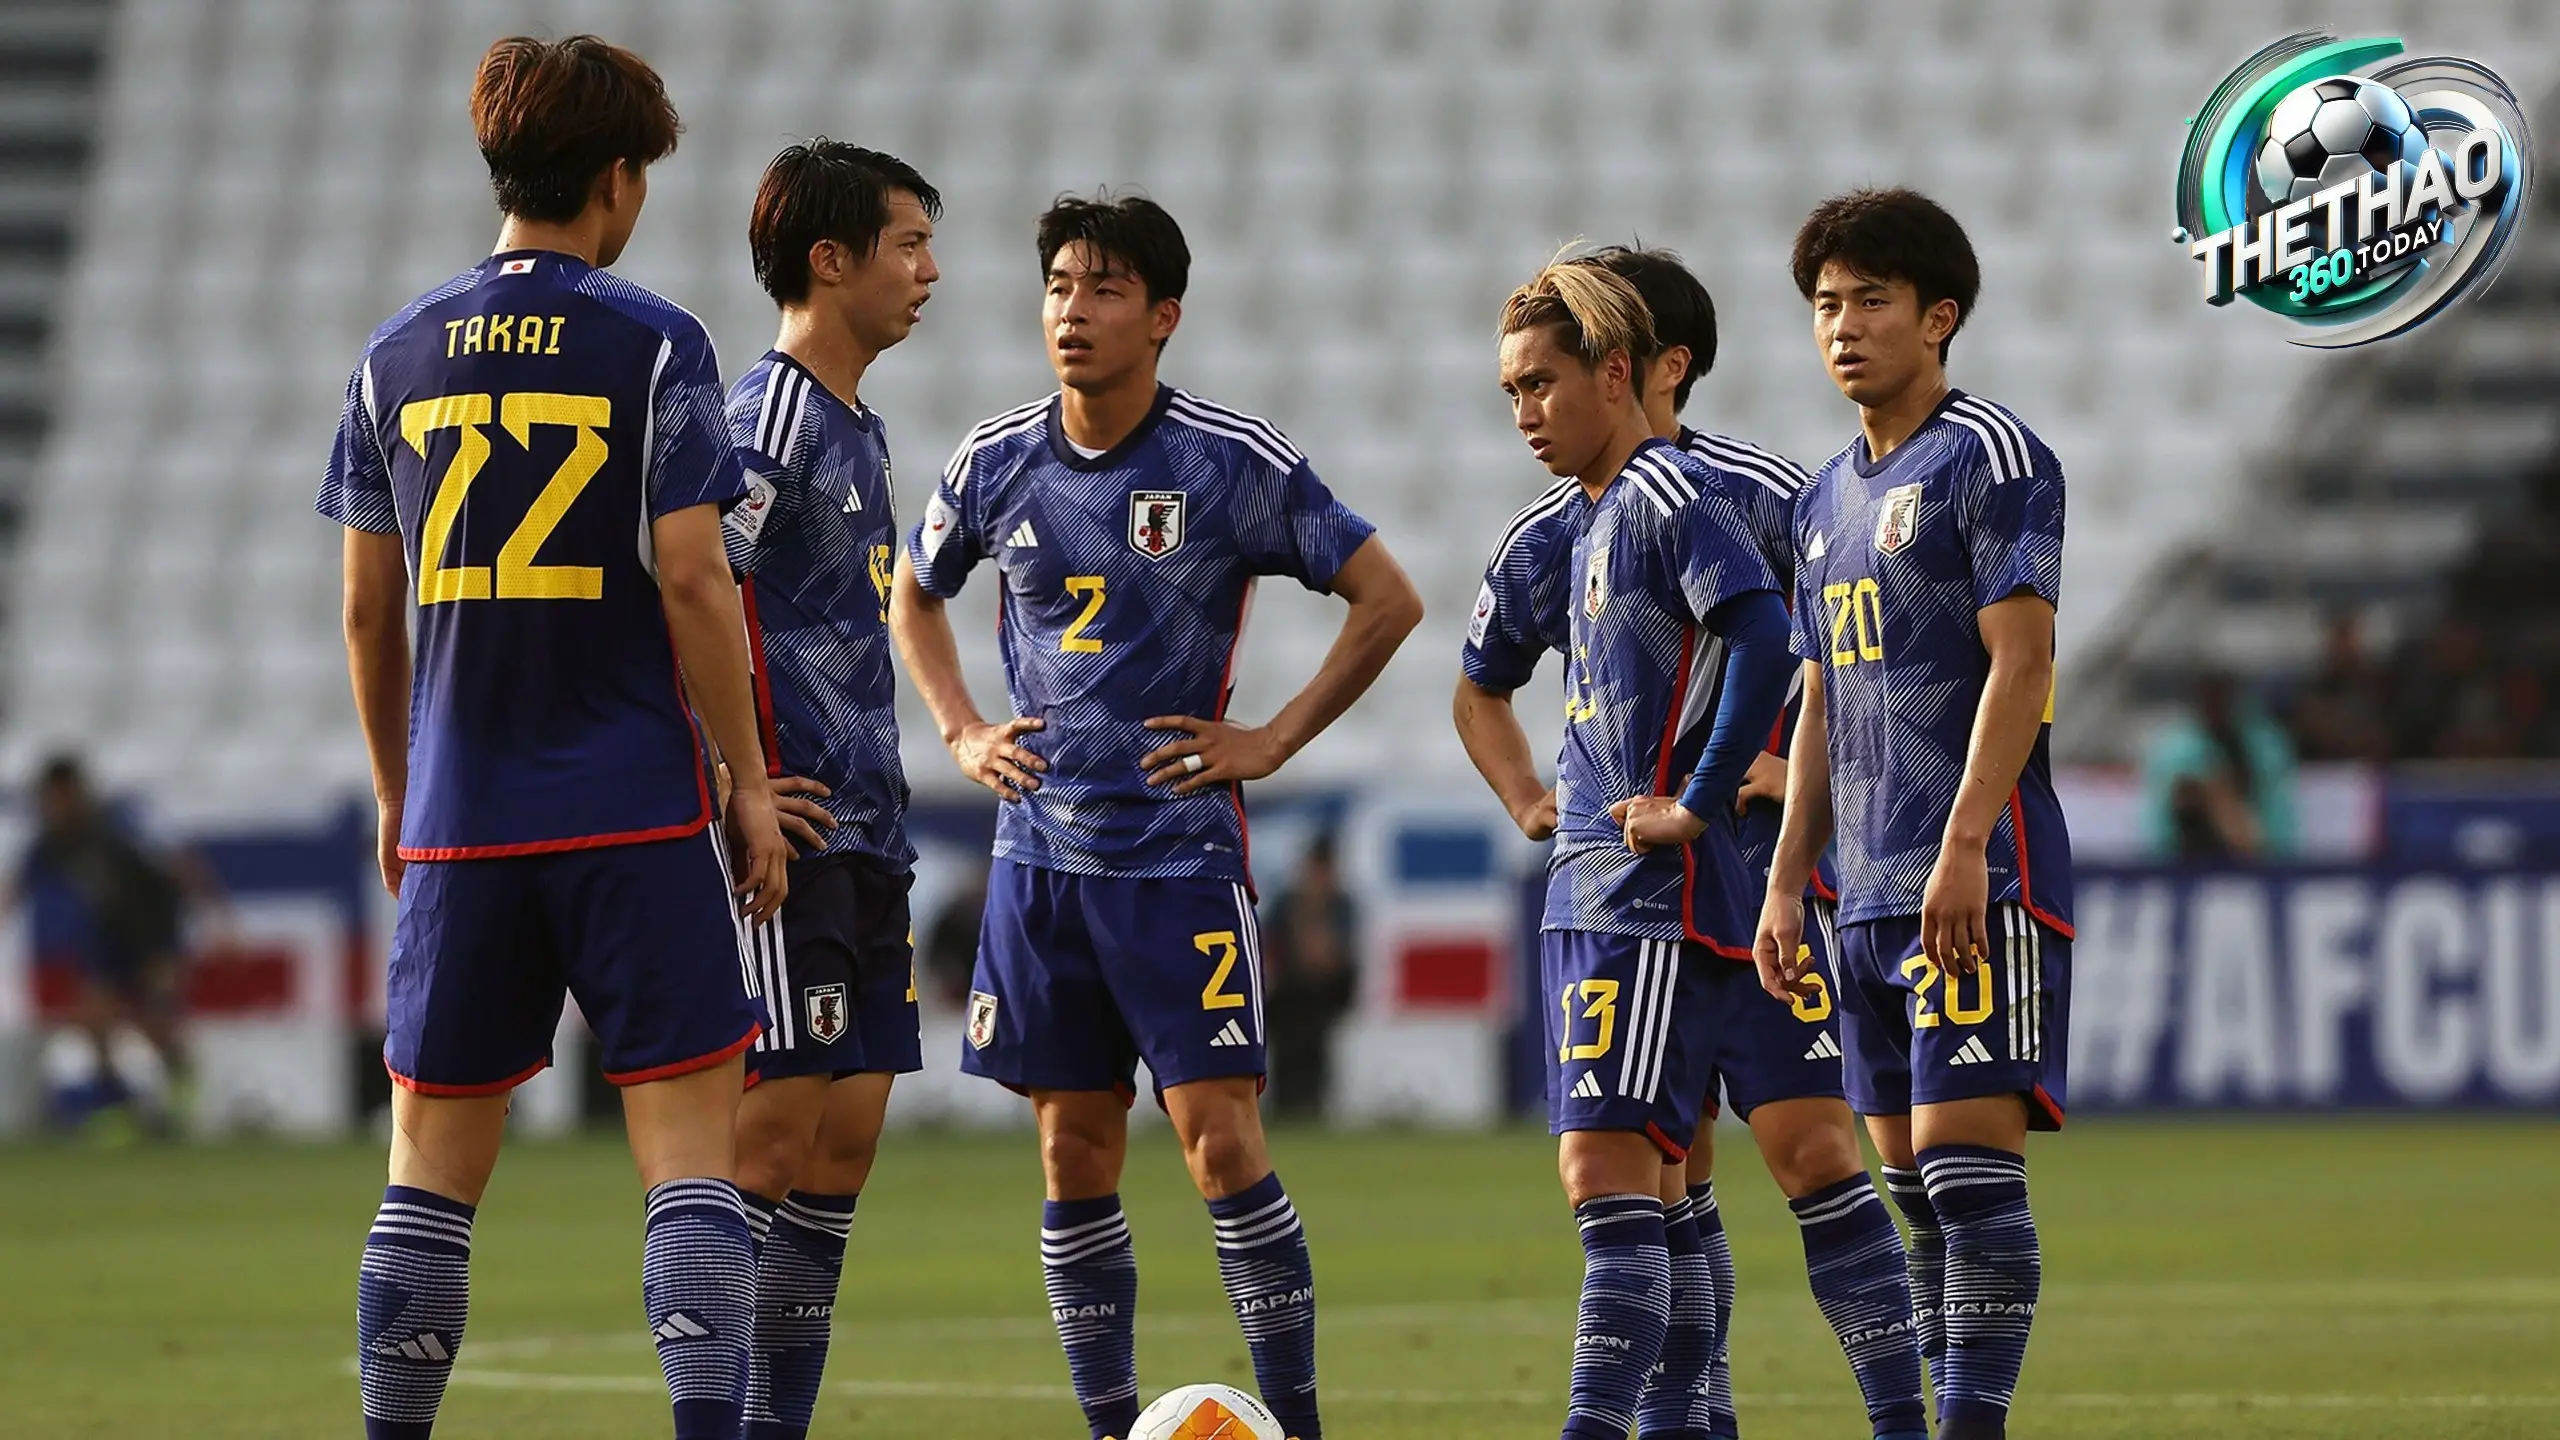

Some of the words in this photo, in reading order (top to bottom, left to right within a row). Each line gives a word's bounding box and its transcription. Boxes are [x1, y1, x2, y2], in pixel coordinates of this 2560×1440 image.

[445, 315, 566, 358] TAKAI
[400, 392, 611, 606] 22
[1060, 575, 1106, 654] 2
[1823, 577, 1883, 669] 20
[1193, 930, 1245, 1010] 2
[1900, 942, 1994, 1029] 20
[1560, 979, 1620, 1064] 13
[1239, 1285, 1313, 1315] JAPAN
[1842, 1314, 1916, 1348] JAPAN
[1944, 1302, 2036, 1316] JAPAN
